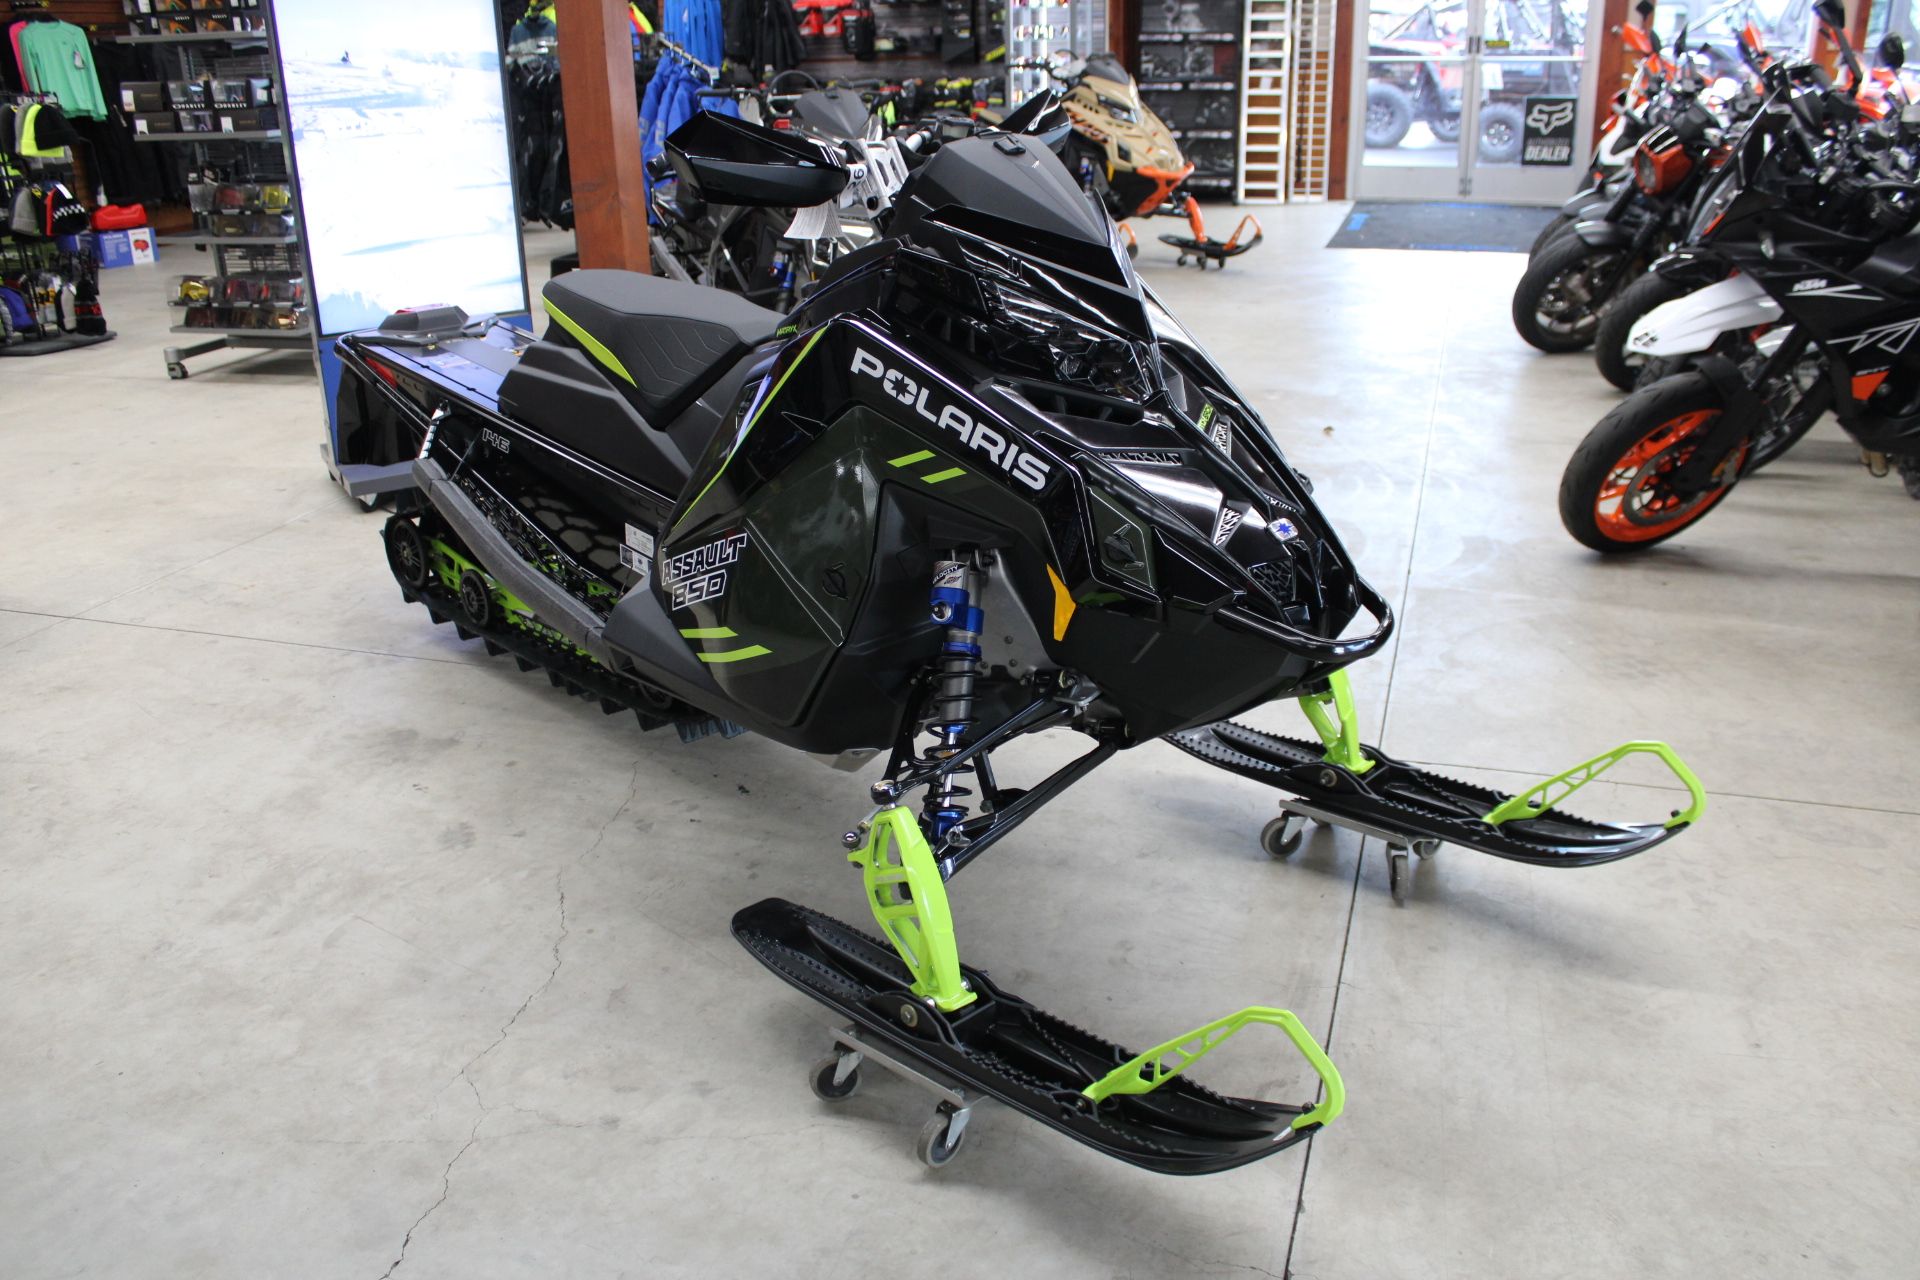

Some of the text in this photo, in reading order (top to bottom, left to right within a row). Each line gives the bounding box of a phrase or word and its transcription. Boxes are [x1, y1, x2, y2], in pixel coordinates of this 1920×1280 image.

[1523, 146, 1571, 161] DEALER
[1792, 278, 1828, 292] KTM
[850, 346, 1051, 491] POLARIS
[482, 427, 510, 454] 146
[661, 532, 748, 586] ASSAULT
[671, 569, 728, 611] 850
